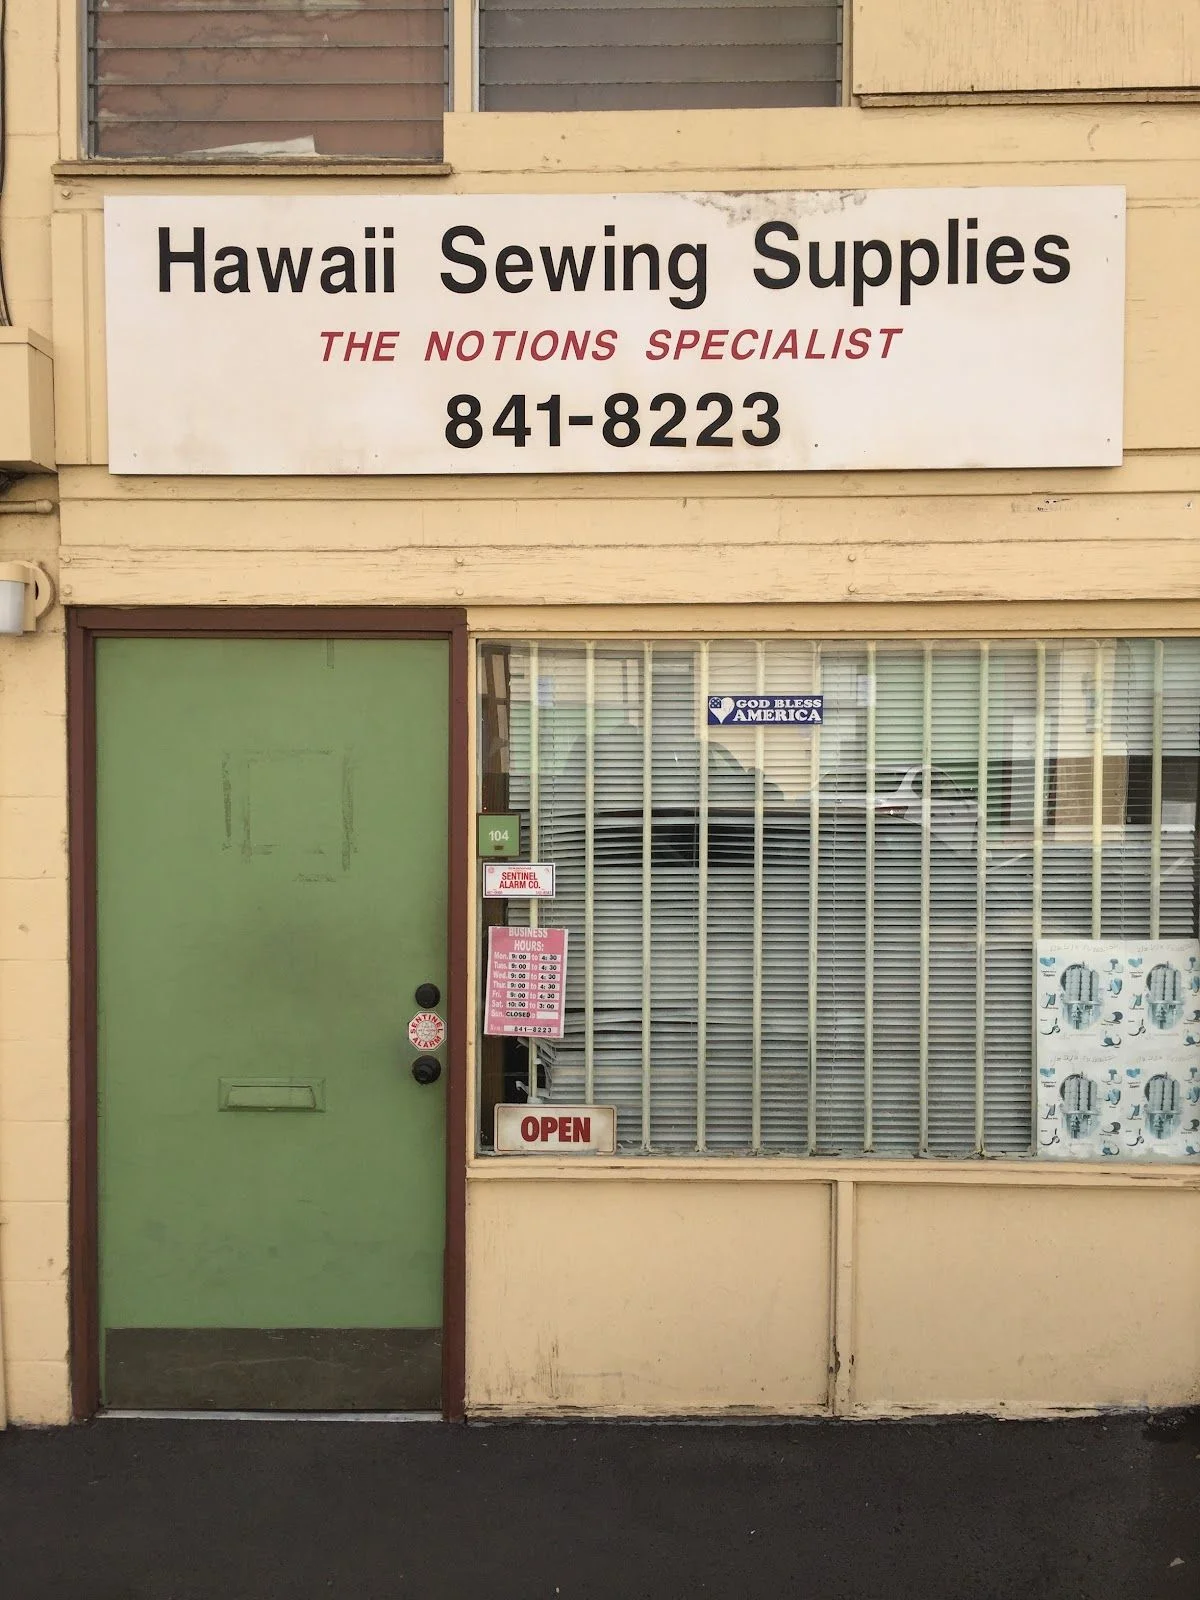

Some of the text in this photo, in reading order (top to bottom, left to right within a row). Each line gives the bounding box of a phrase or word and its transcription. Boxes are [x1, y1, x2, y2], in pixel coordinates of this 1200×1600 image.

[158, 217, 1071, 310] Hawaii Sewing Supplies
[321, 327, 903, 363] THE NOTIONS SPECIALIST
[445, 391, 781, 448] 841-8223
[735, 699, 821, 708] GOD BLESS
[733, 709, 822, 721] AMERICA
[489, 830, 509, 841] 104
[501, 871, 538, 880] SENTINEL
[499, 880, 541, 889] ALARM CO.
[508, 927, 548, 938] BUSINESS
[514, 939, 544, 952] HOURS:
[410, 1014, 444, 1034] SENTINEL
[412, 1035, 442, 1048] ALARM
[520, 1115, 591, 1142] OPEN
